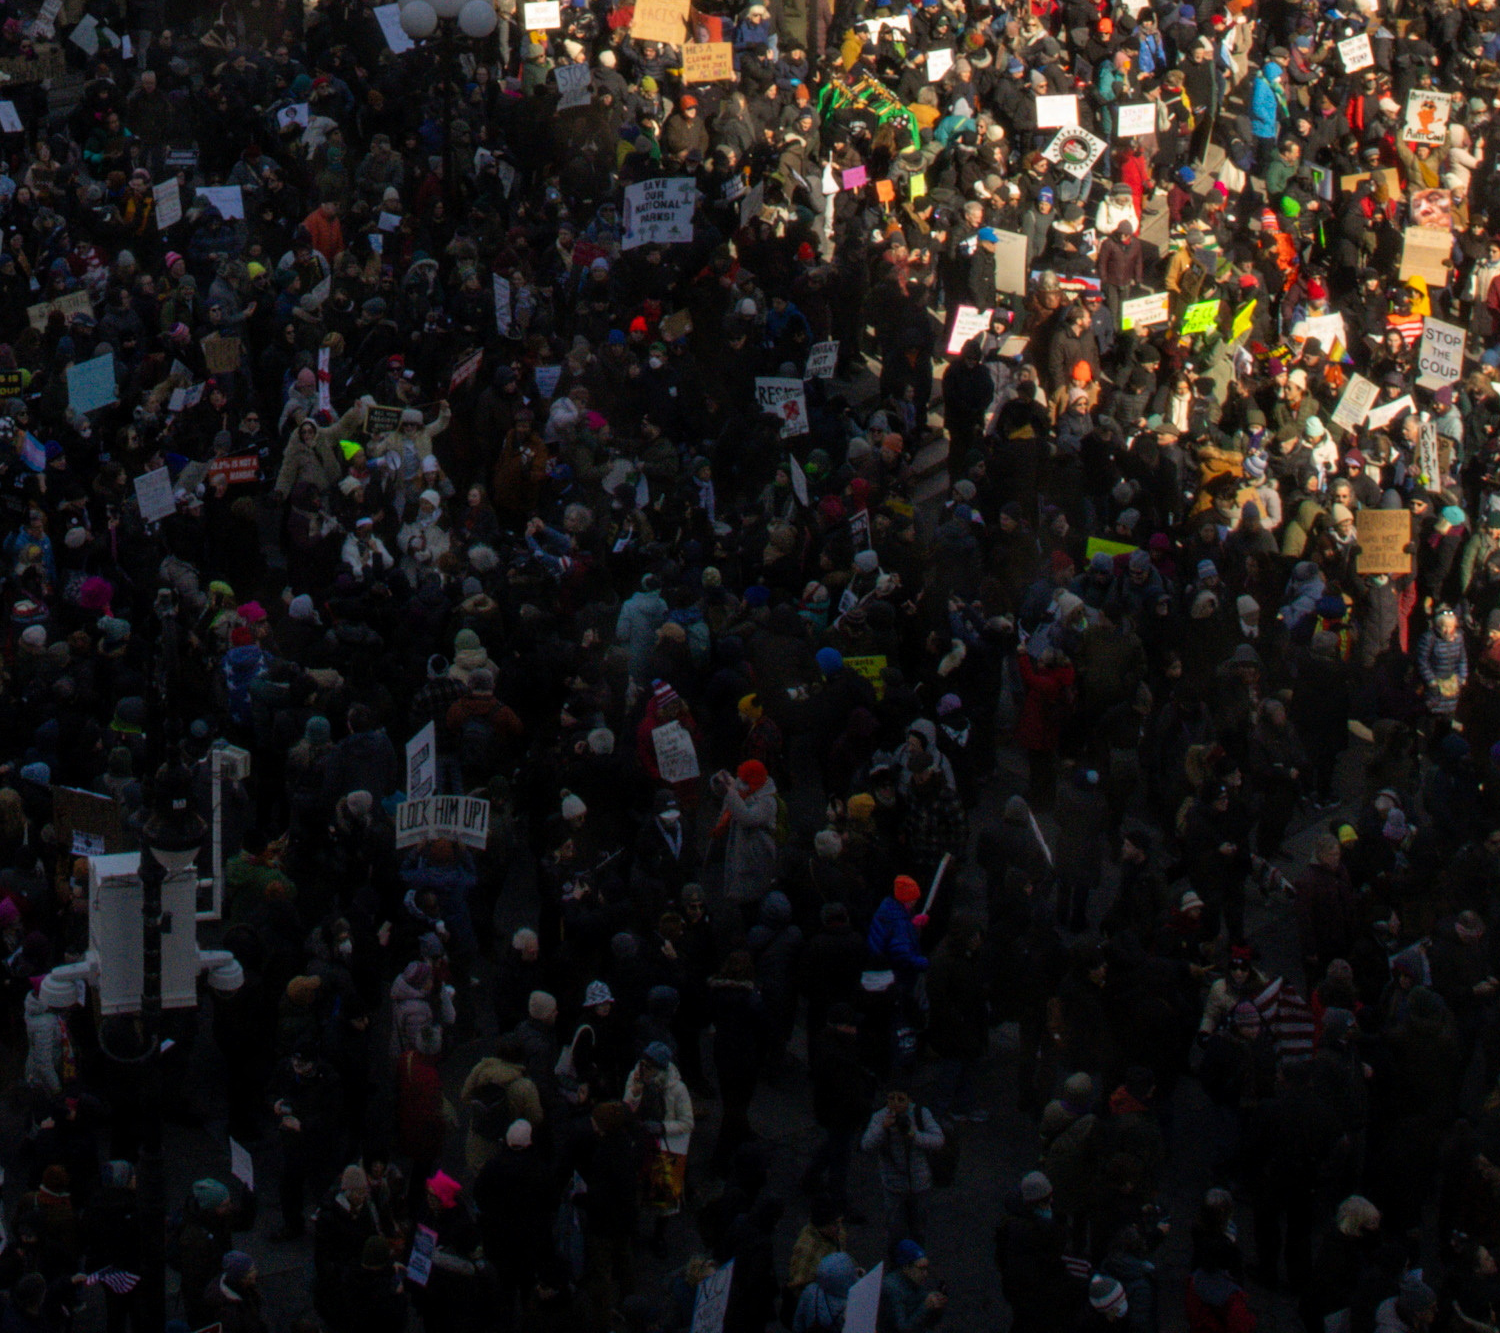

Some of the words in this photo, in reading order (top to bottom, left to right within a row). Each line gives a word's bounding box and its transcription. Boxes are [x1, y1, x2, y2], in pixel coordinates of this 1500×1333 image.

[643, 179, 667, 191] SAVE
[644, 190, 665, 200] OUR
[635, 199, 681, 213] NATIONAL
[640, 212, 675, 222] PARKS!
[1425, 327, 1462, 347] STOP
[1432, 346, 1450, 361] THE
[1420, 357, 1460, 379] COUP
[7, 375, 19, 383] IS
[400, 799, 431, 832] LOCK
[433, 798, 459, 826] HIM
[463, 797, 487, 832] UP!
